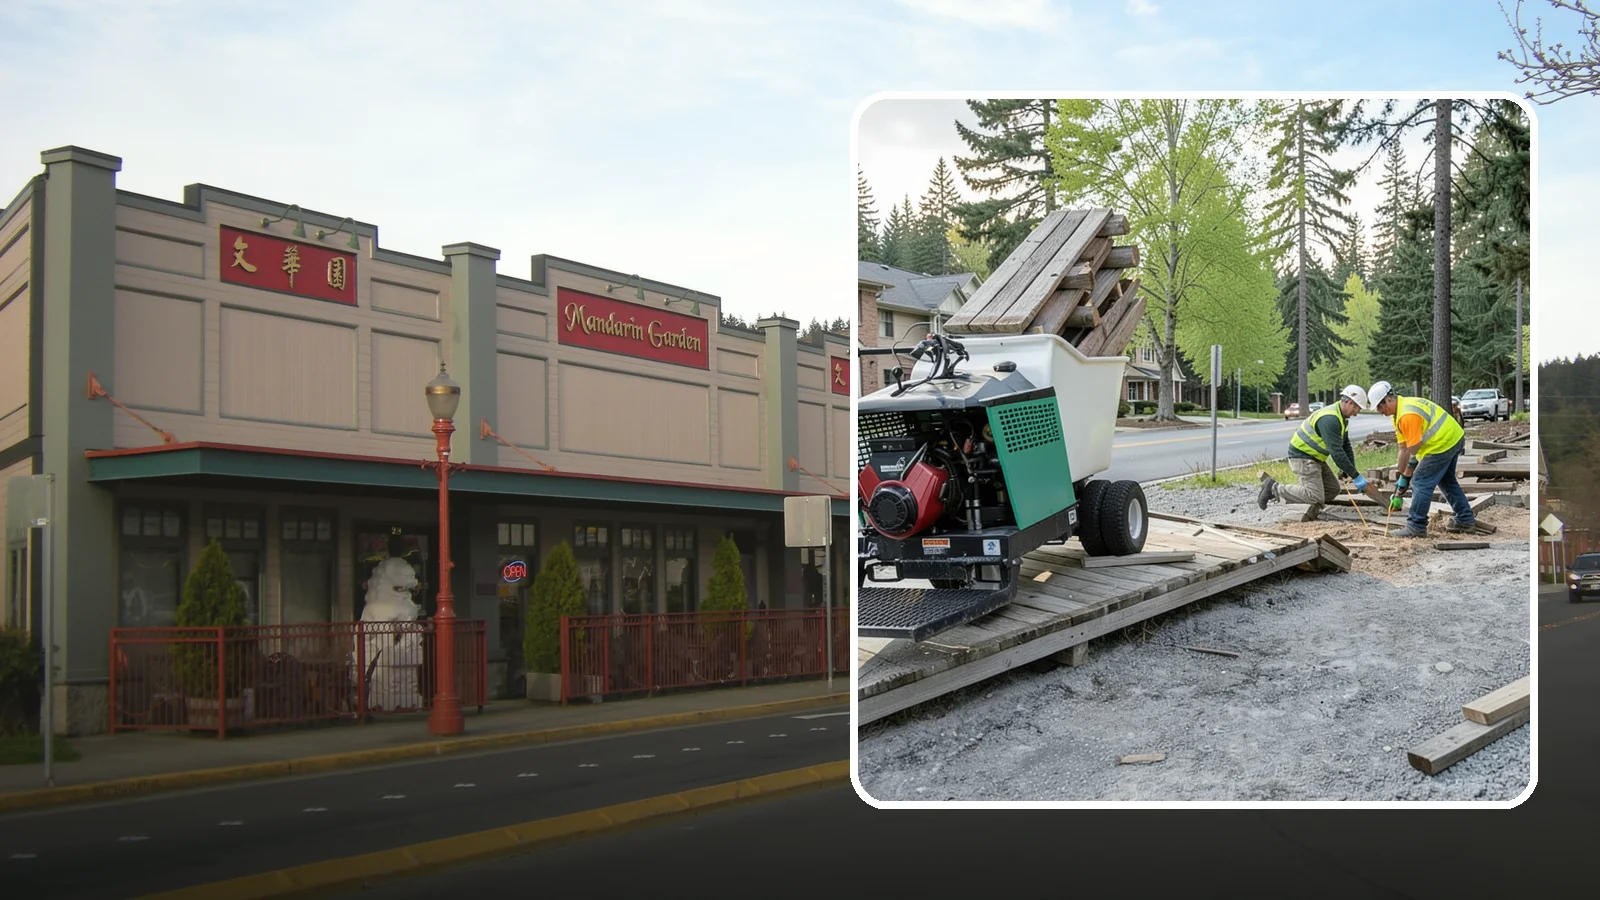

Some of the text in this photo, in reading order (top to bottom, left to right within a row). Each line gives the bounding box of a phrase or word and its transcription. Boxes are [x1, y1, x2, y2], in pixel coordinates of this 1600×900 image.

[565, 302, 701, 352] Mandarin Garden
[503, 565, 527, 578] OPEN
